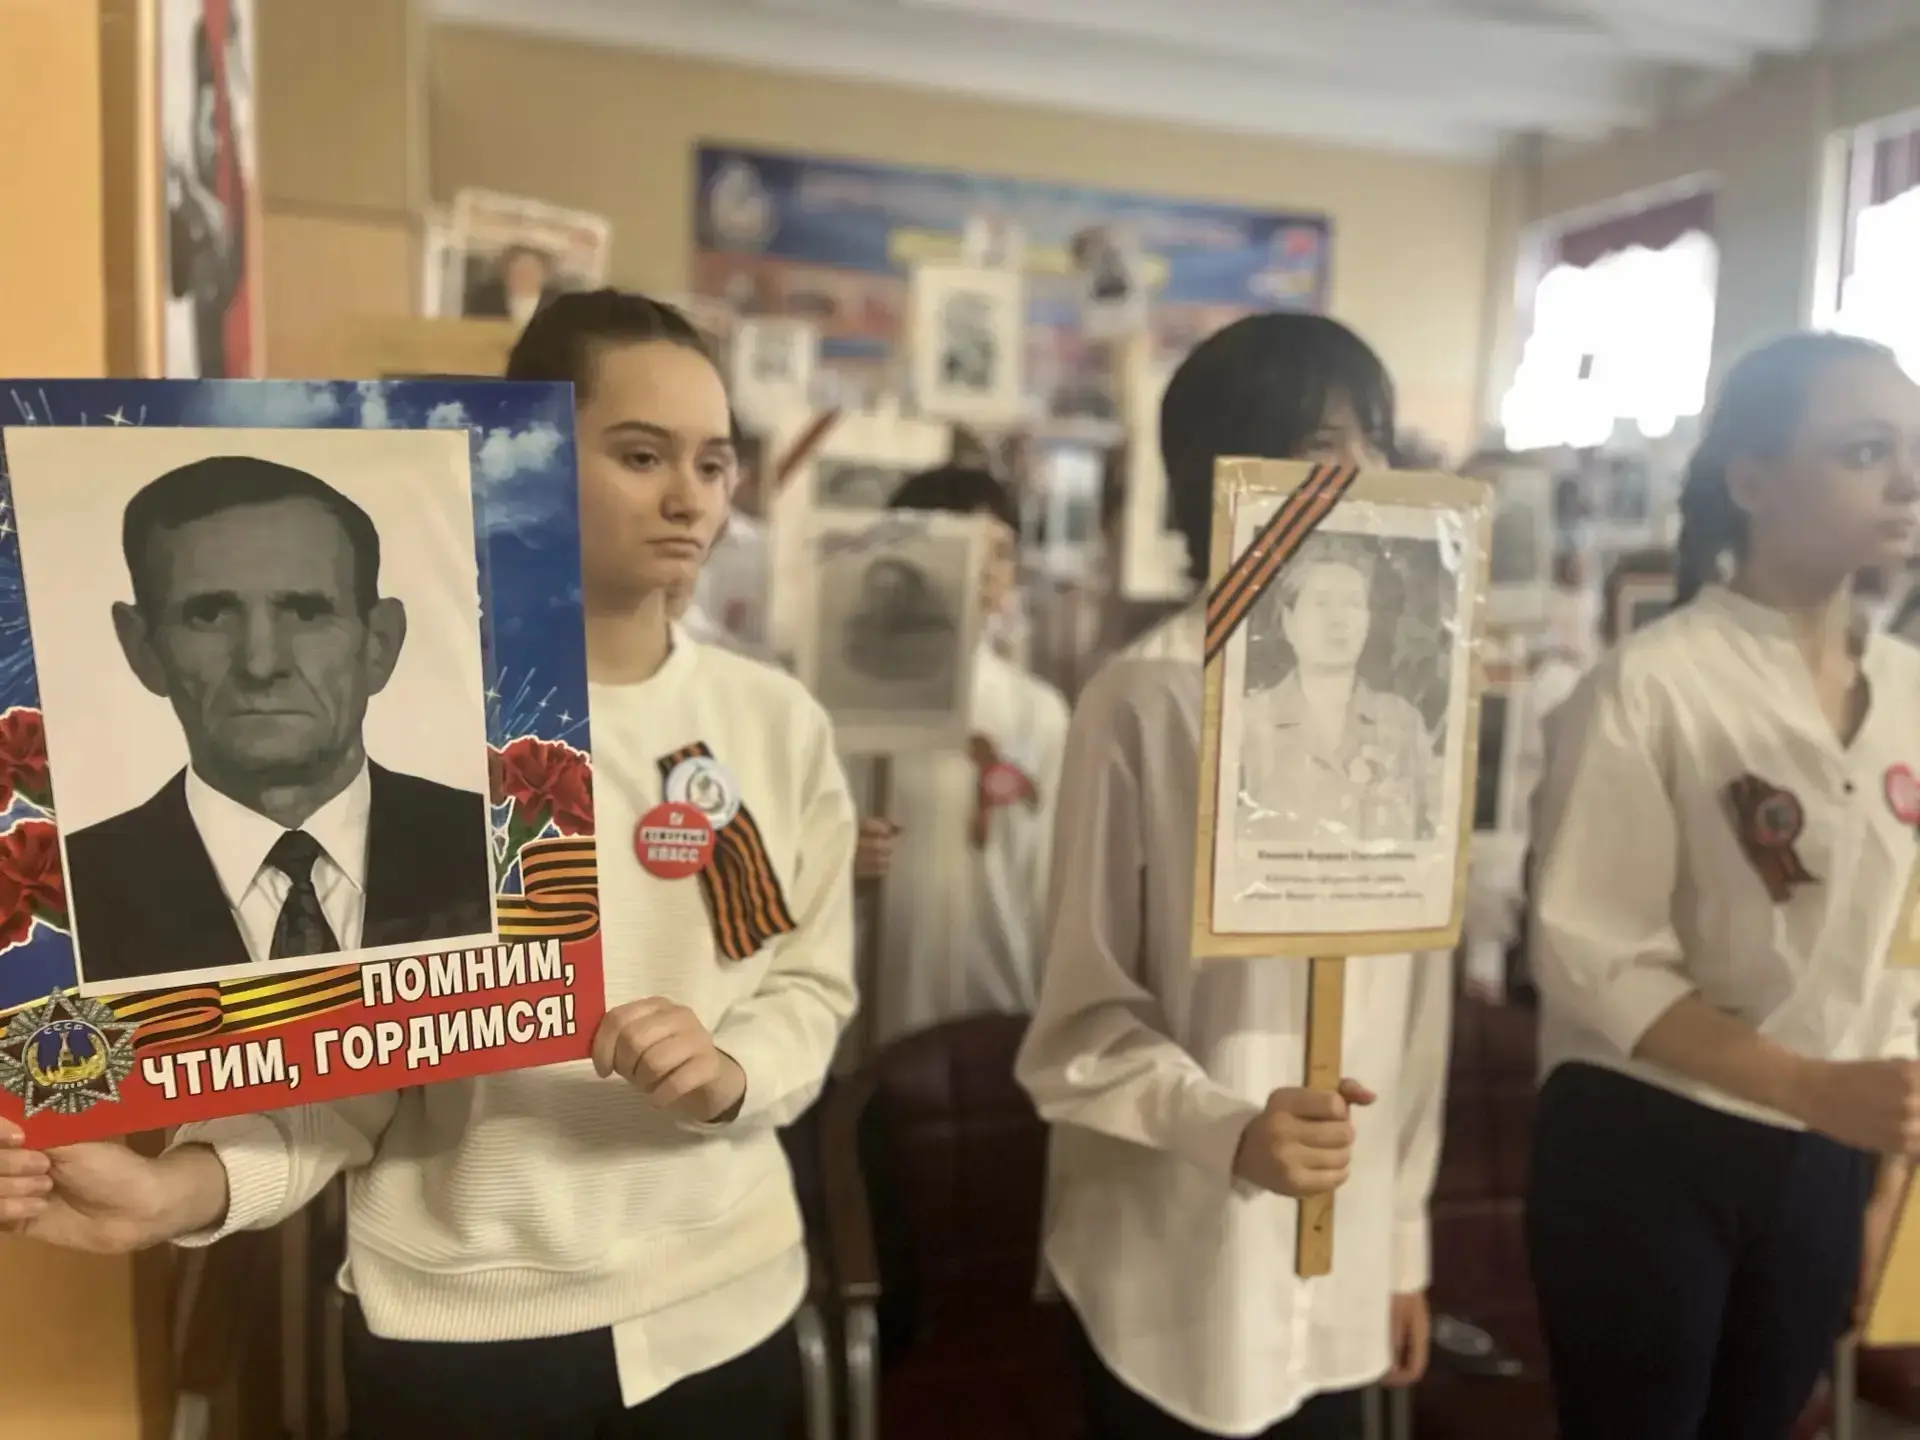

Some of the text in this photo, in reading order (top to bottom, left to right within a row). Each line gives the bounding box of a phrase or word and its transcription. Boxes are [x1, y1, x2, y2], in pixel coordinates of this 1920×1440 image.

[361, 938, 575, 1007] ПОМНИМ,
[142, 994, 576, 1099] ЧТИМ, ГОРДИМСЯ!
